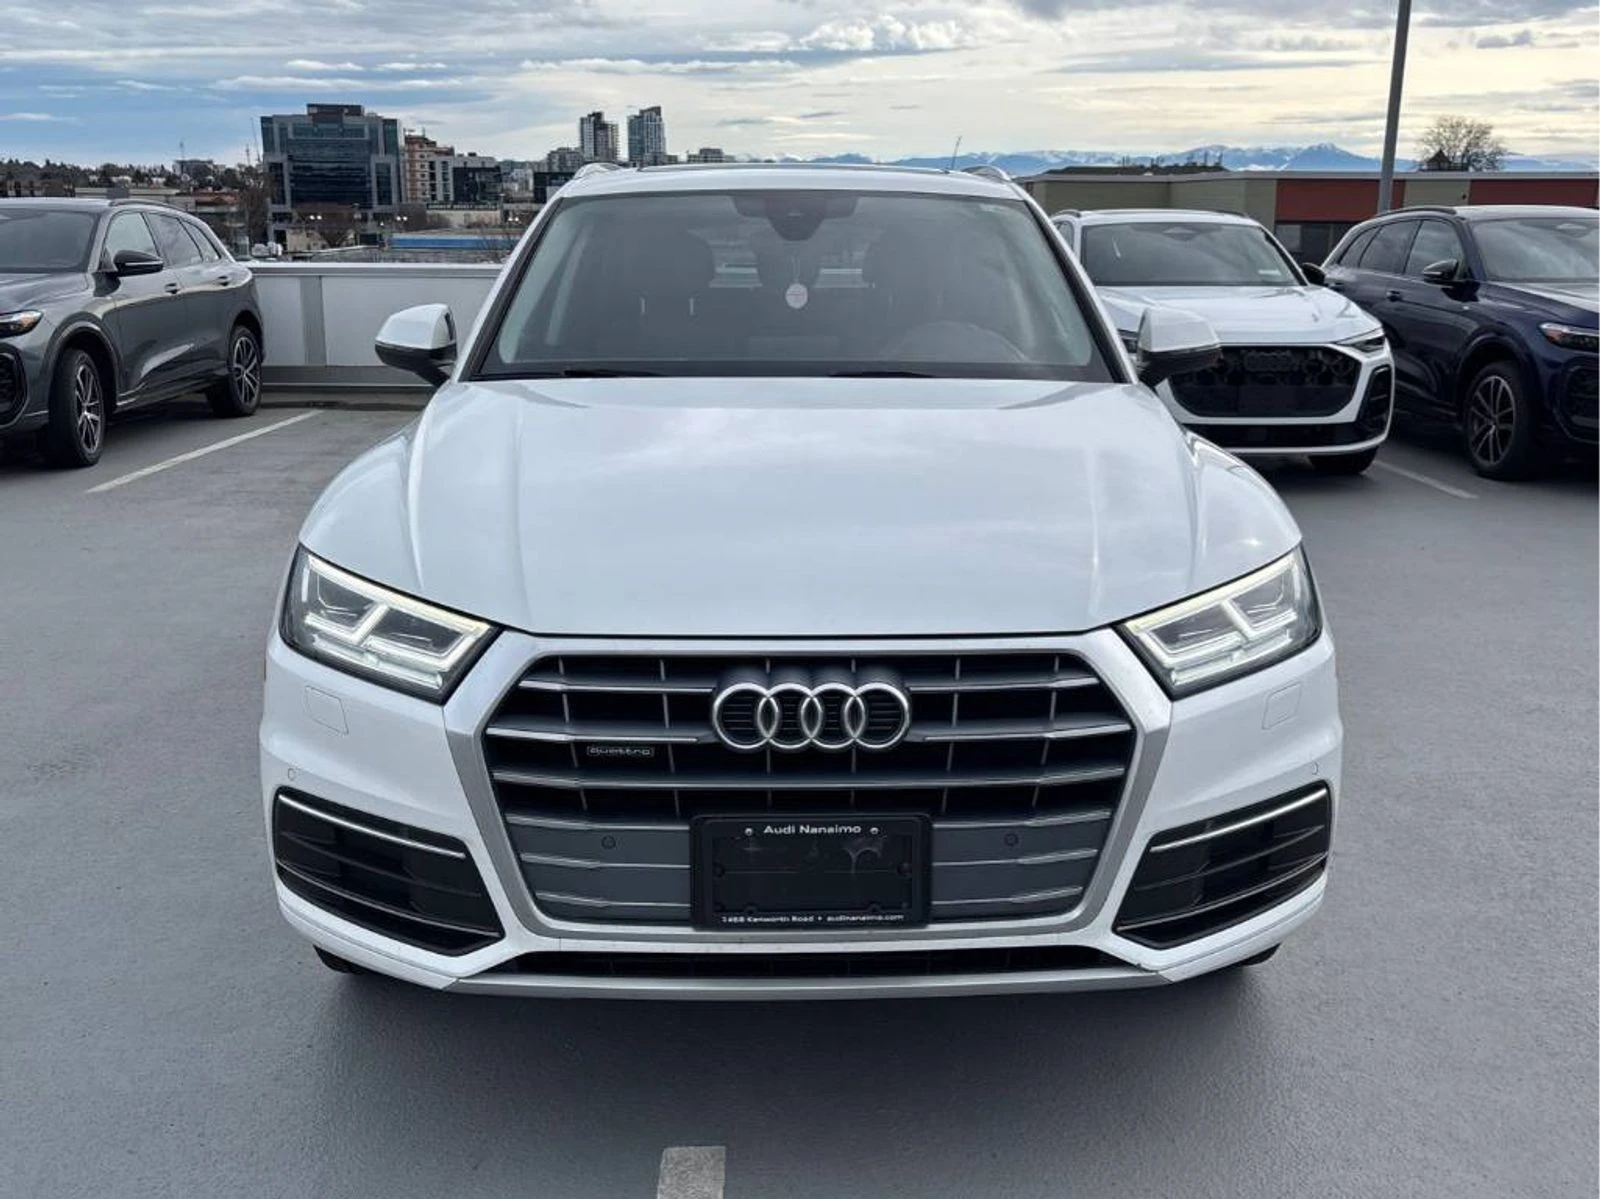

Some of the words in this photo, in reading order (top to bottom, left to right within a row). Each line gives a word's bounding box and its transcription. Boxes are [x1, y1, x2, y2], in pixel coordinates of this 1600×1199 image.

[589, 746, 652, 757] quattro
[763, 824, 796, 835] Audi
[799, 824, 862, 834] Nanaimo
[791, 914, 815, 923] Road
